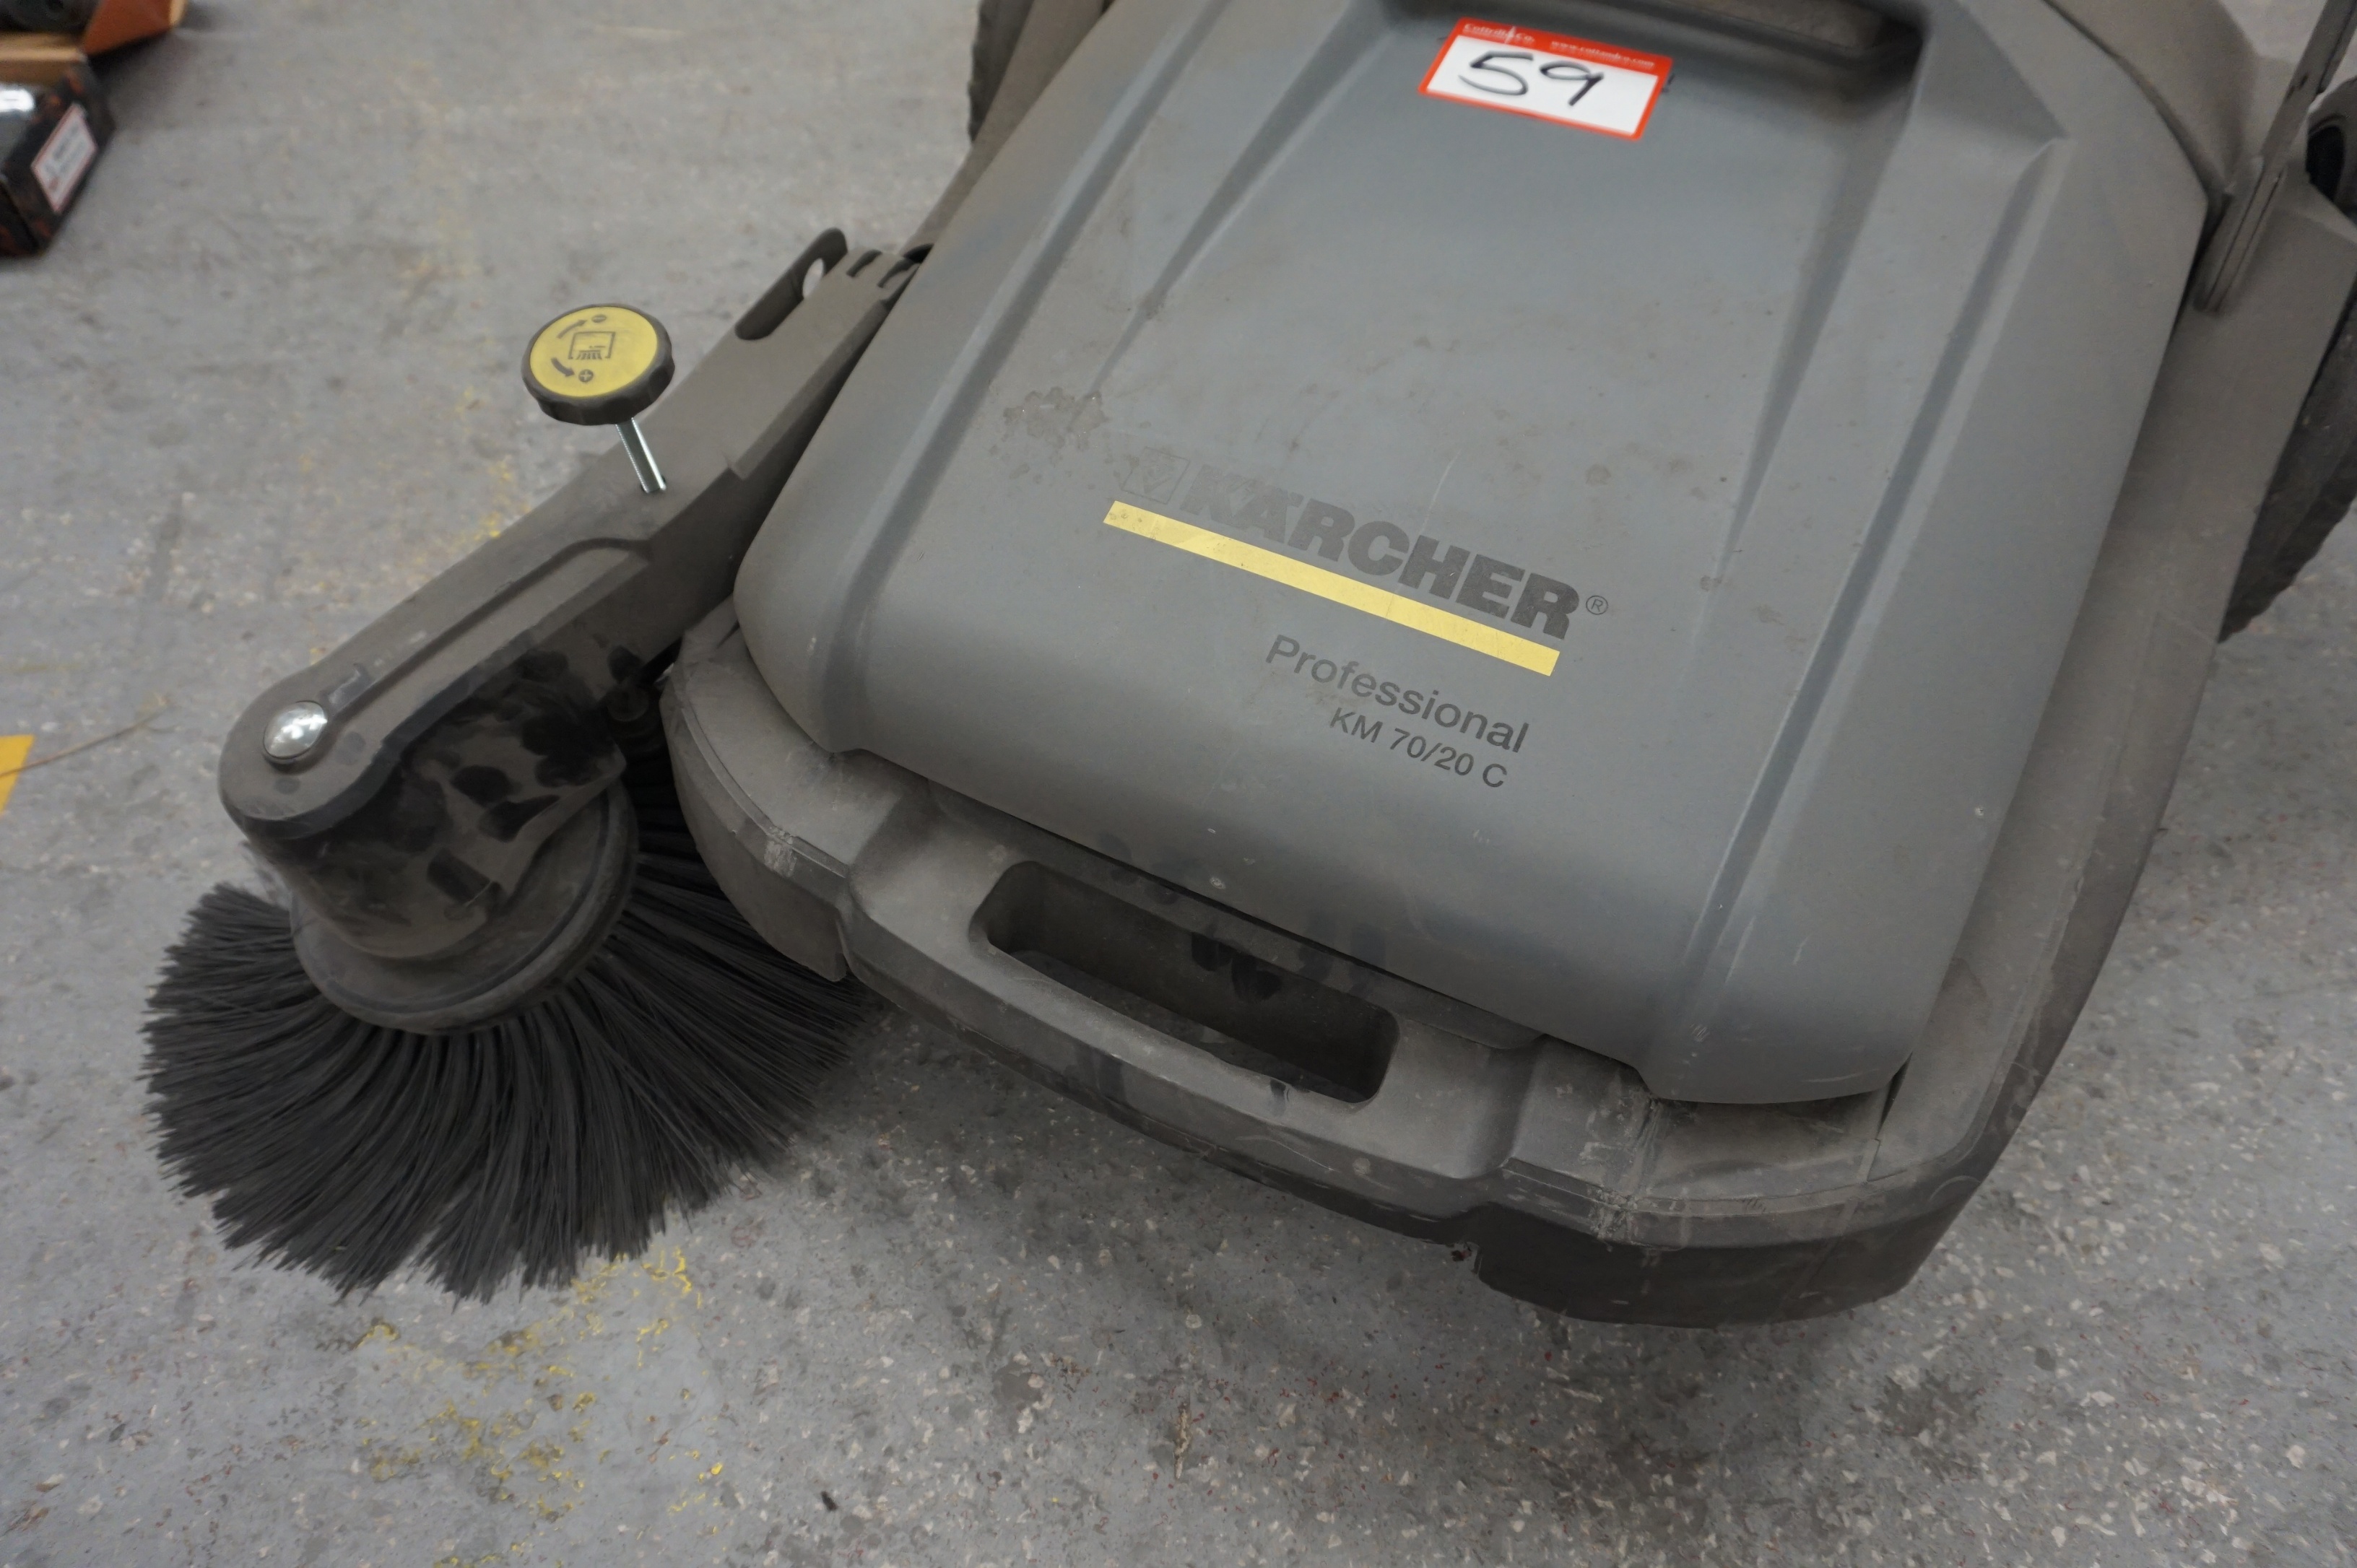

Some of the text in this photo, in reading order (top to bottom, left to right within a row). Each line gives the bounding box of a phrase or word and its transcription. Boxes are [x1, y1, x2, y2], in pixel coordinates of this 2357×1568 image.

[1458, 51, 1605, 106] 59
[1265, 634, 1529, 753] Professional
[1329, 707, 1508, 788] KM 70/20 C
